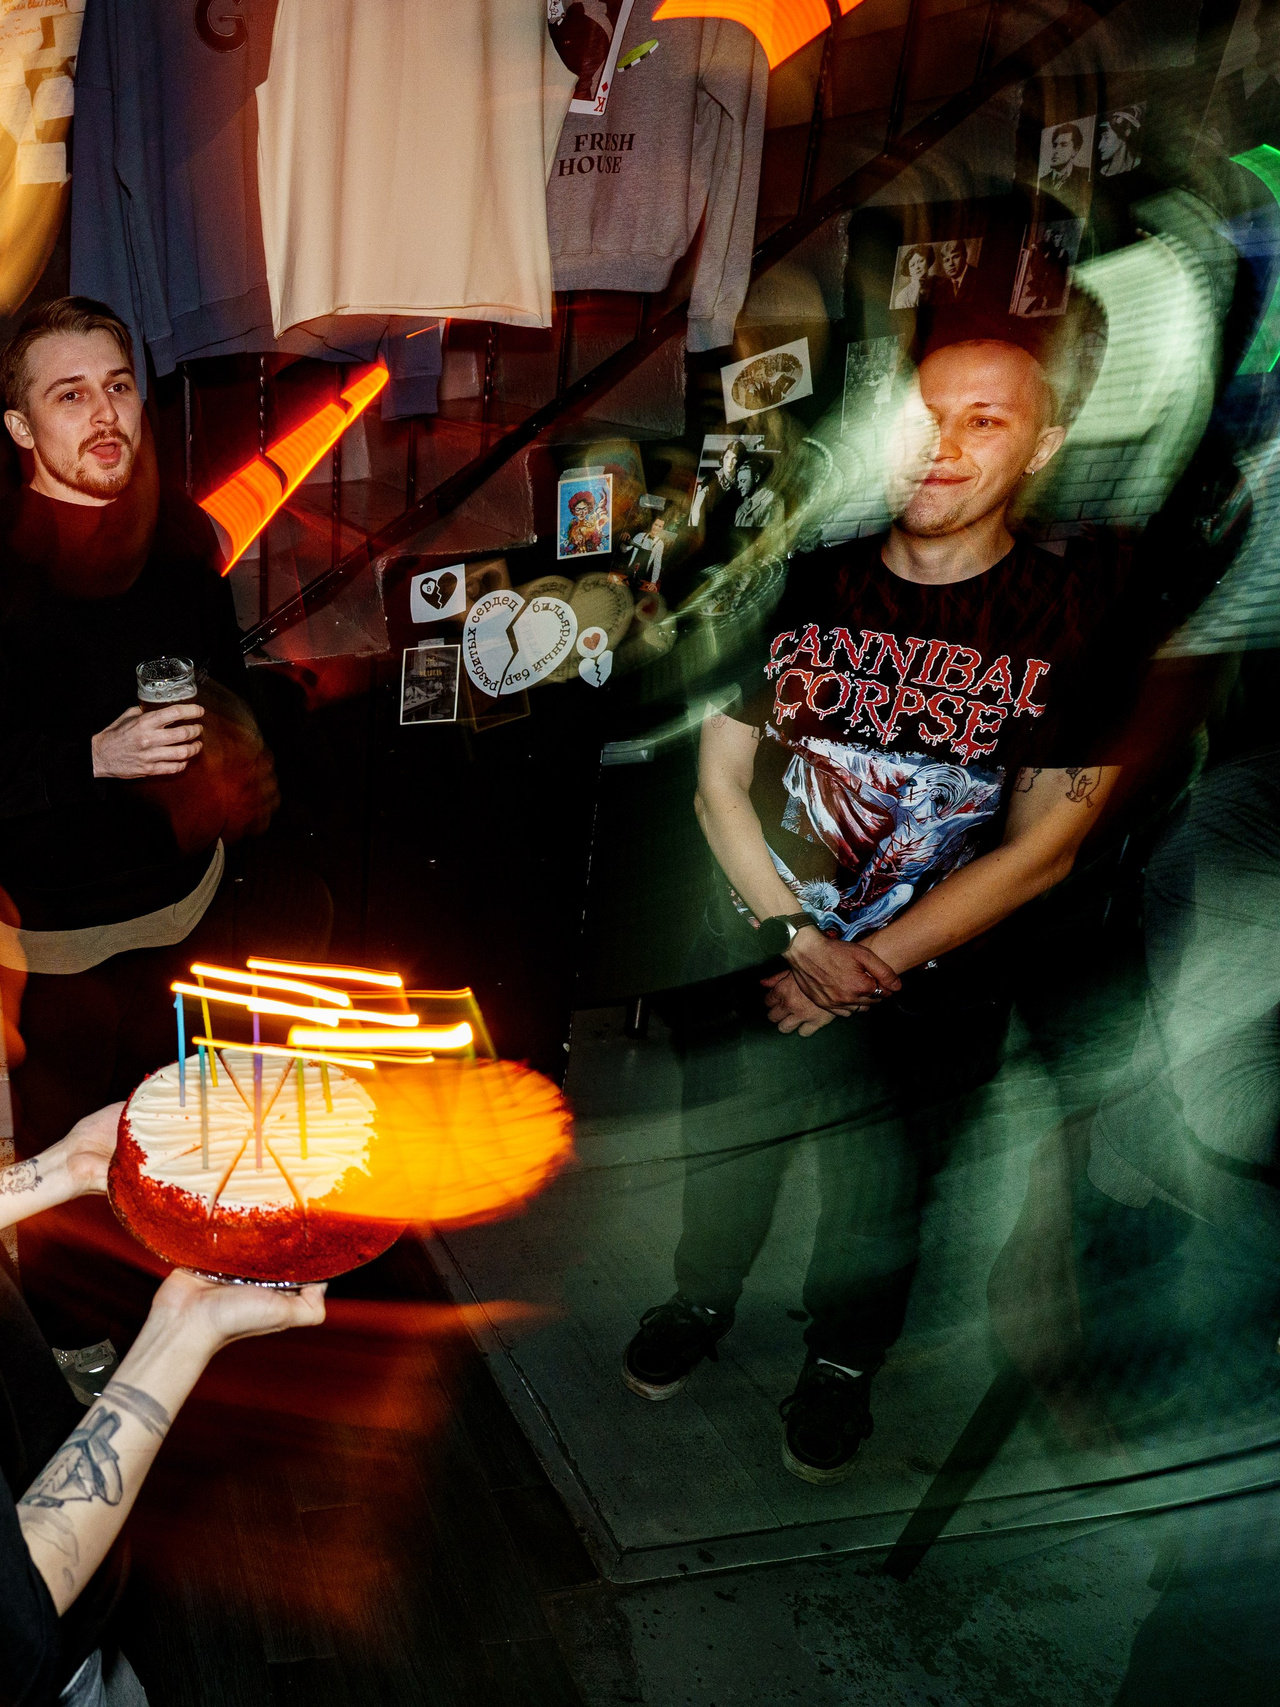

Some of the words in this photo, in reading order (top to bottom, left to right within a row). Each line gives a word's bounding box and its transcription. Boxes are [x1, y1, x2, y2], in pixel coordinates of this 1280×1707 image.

[574, 132, 636, 152] FRESH
[558, 155, 622, 177] HOUSE
[471, 596, 519, 624] сердец
[467, 627, 500, 691] разбитых
[532, 601, 570, 672] бильярдный
[504, 668, 531, 686] бар
[764, 623, 1050, 718] CANNIBAL
[773, 668, 1008, 766] CORPSE
